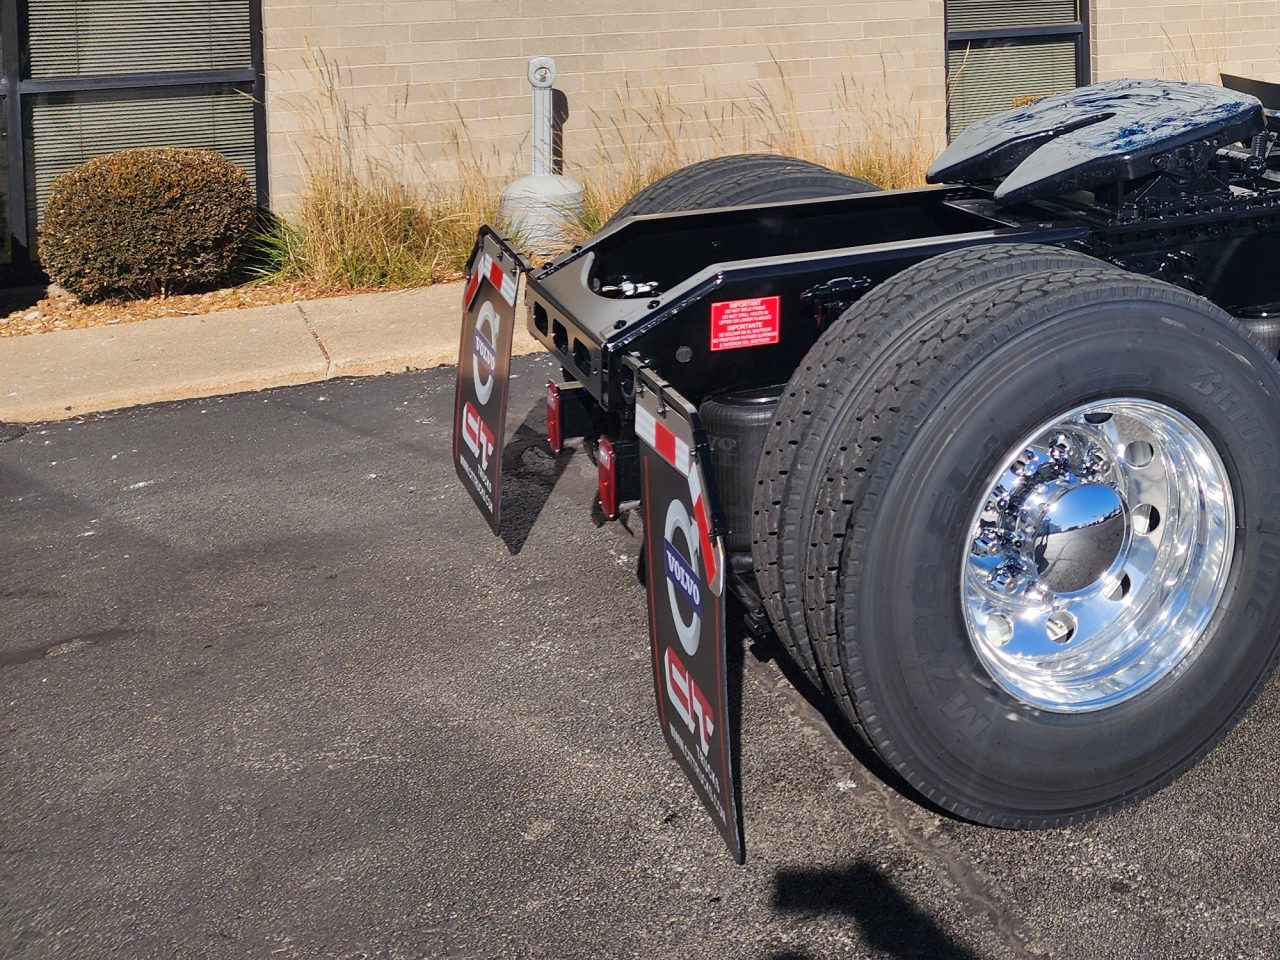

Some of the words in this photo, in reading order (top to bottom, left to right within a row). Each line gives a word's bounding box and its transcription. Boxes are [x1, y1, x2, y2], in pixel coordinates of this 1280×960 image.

[729, 300, 761, 308] IMPORTANT
[475, 336, 496, 371] VOLVO
[665, 549, 701, 607] VOLVO
